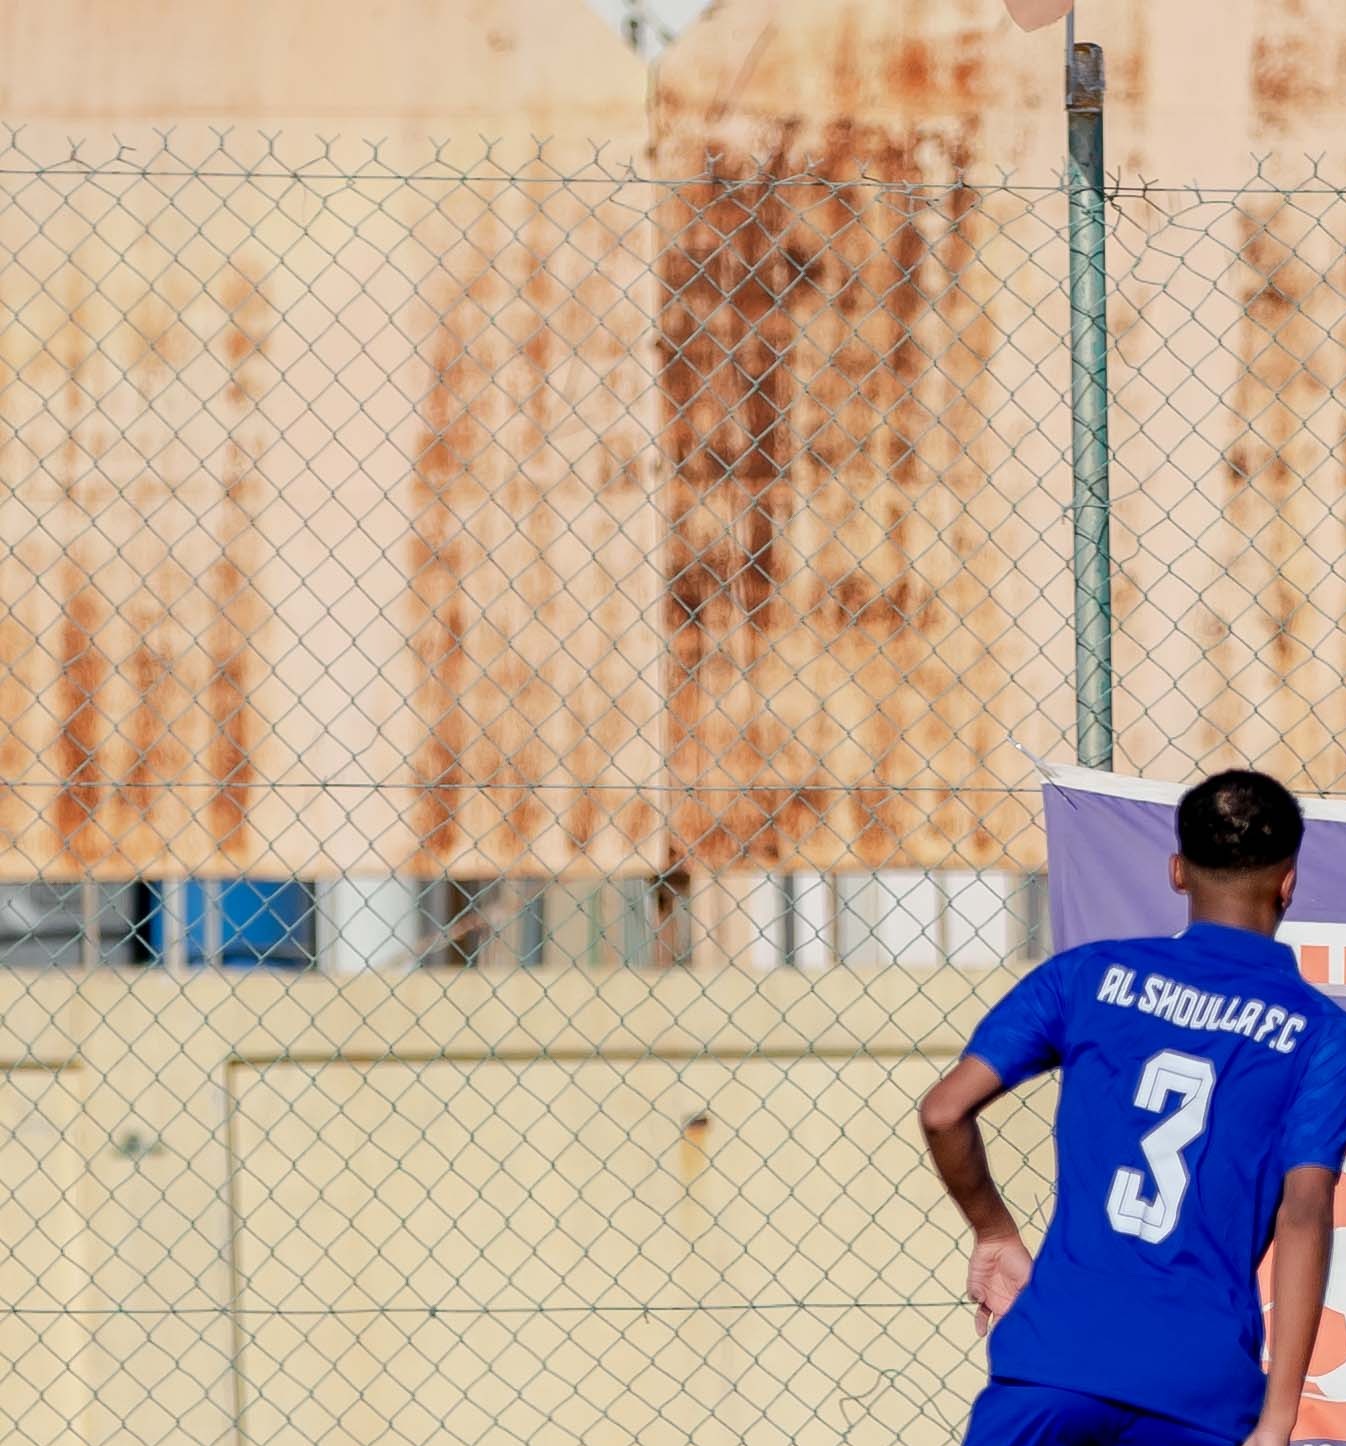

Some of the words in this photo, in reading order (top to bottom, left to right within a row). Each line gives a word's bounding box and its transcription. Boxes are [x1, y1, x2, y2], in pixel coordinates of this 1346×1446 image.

[1097, 963, 1137, 1008] AL
[1137, 974, 1266, 1039] SHOULLA
[1106, 1047, 1216, 1245] 3
